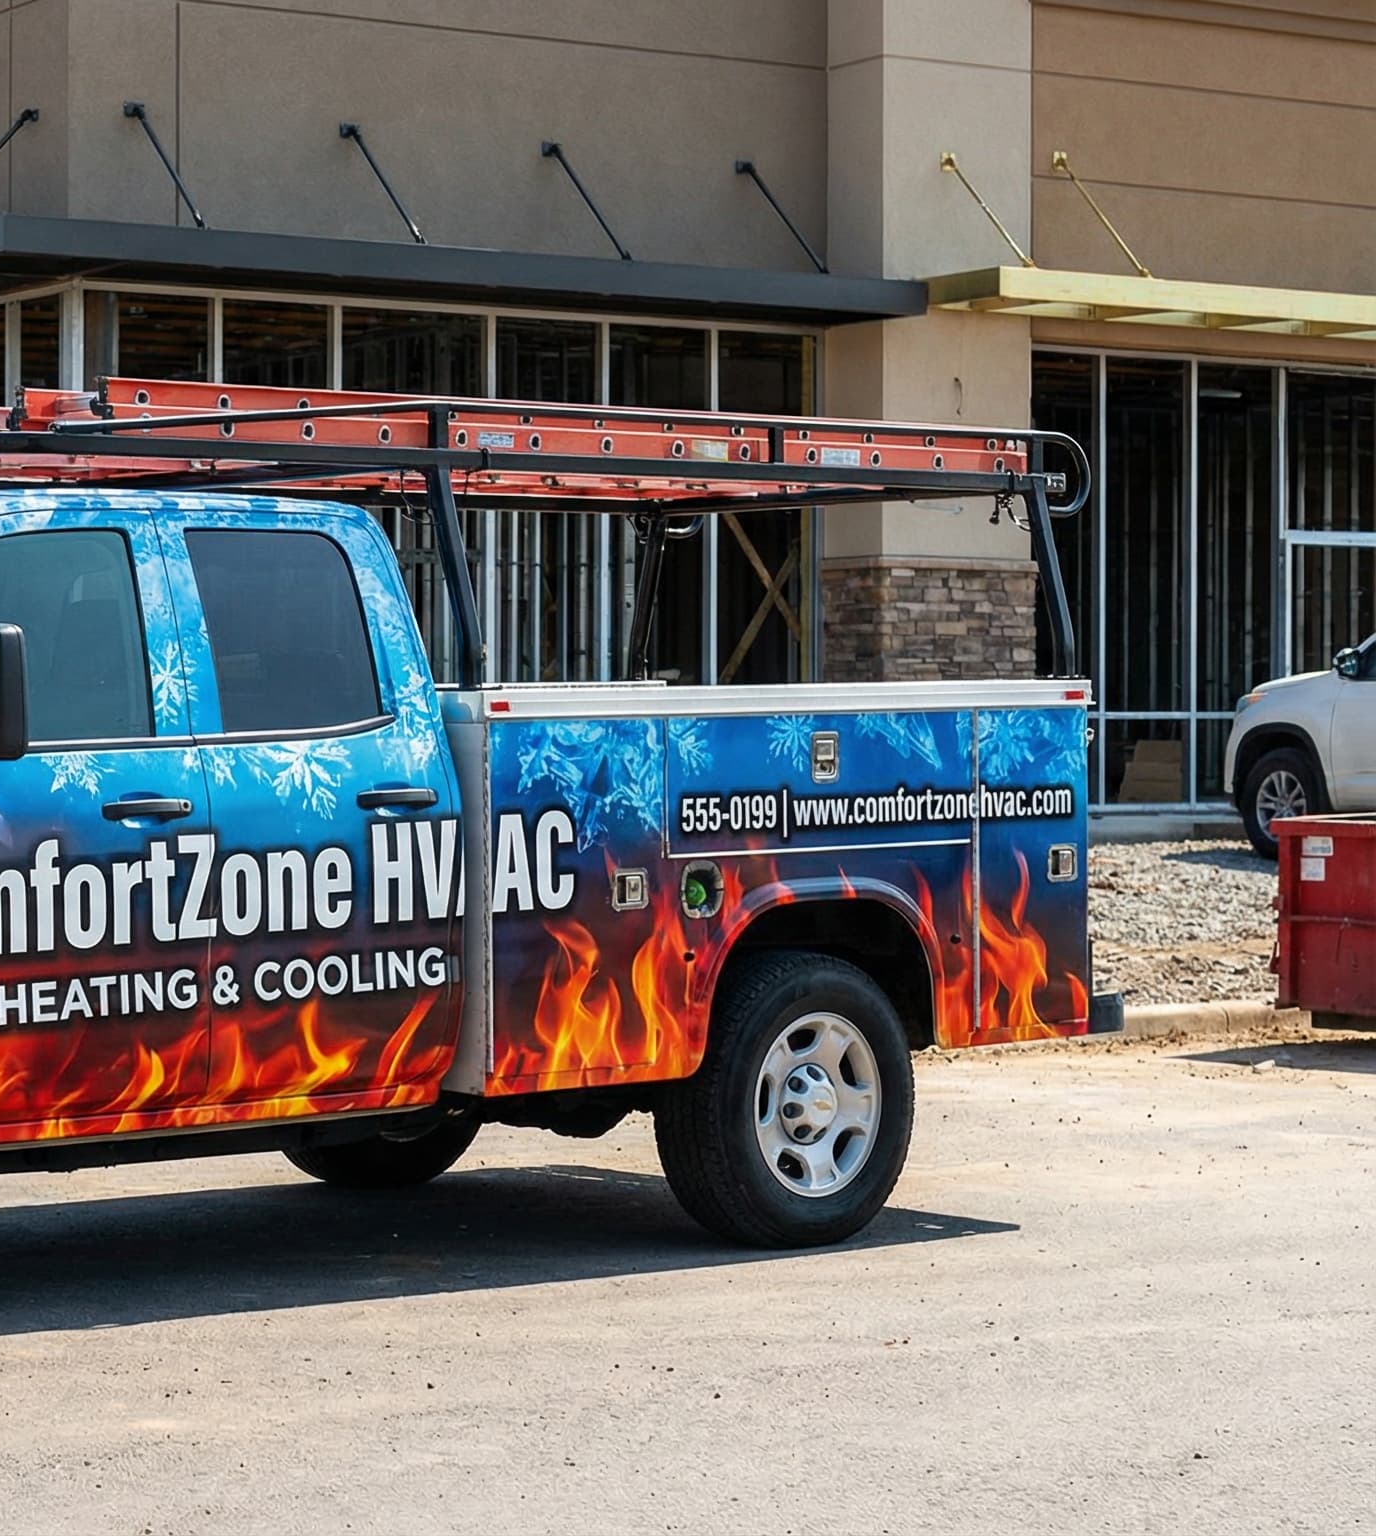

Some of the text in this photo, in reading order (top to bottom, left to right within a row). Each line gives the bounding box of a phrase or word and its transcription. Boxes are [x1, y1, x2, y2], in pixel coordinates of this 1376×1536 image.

[682, 795, 777, 832] 555-0199
[793, 784, 1072, 826] www.comfortzonehvac.com
[212, 965, 240, 1005] &
[254, 947, 446, 1001] COOLING
